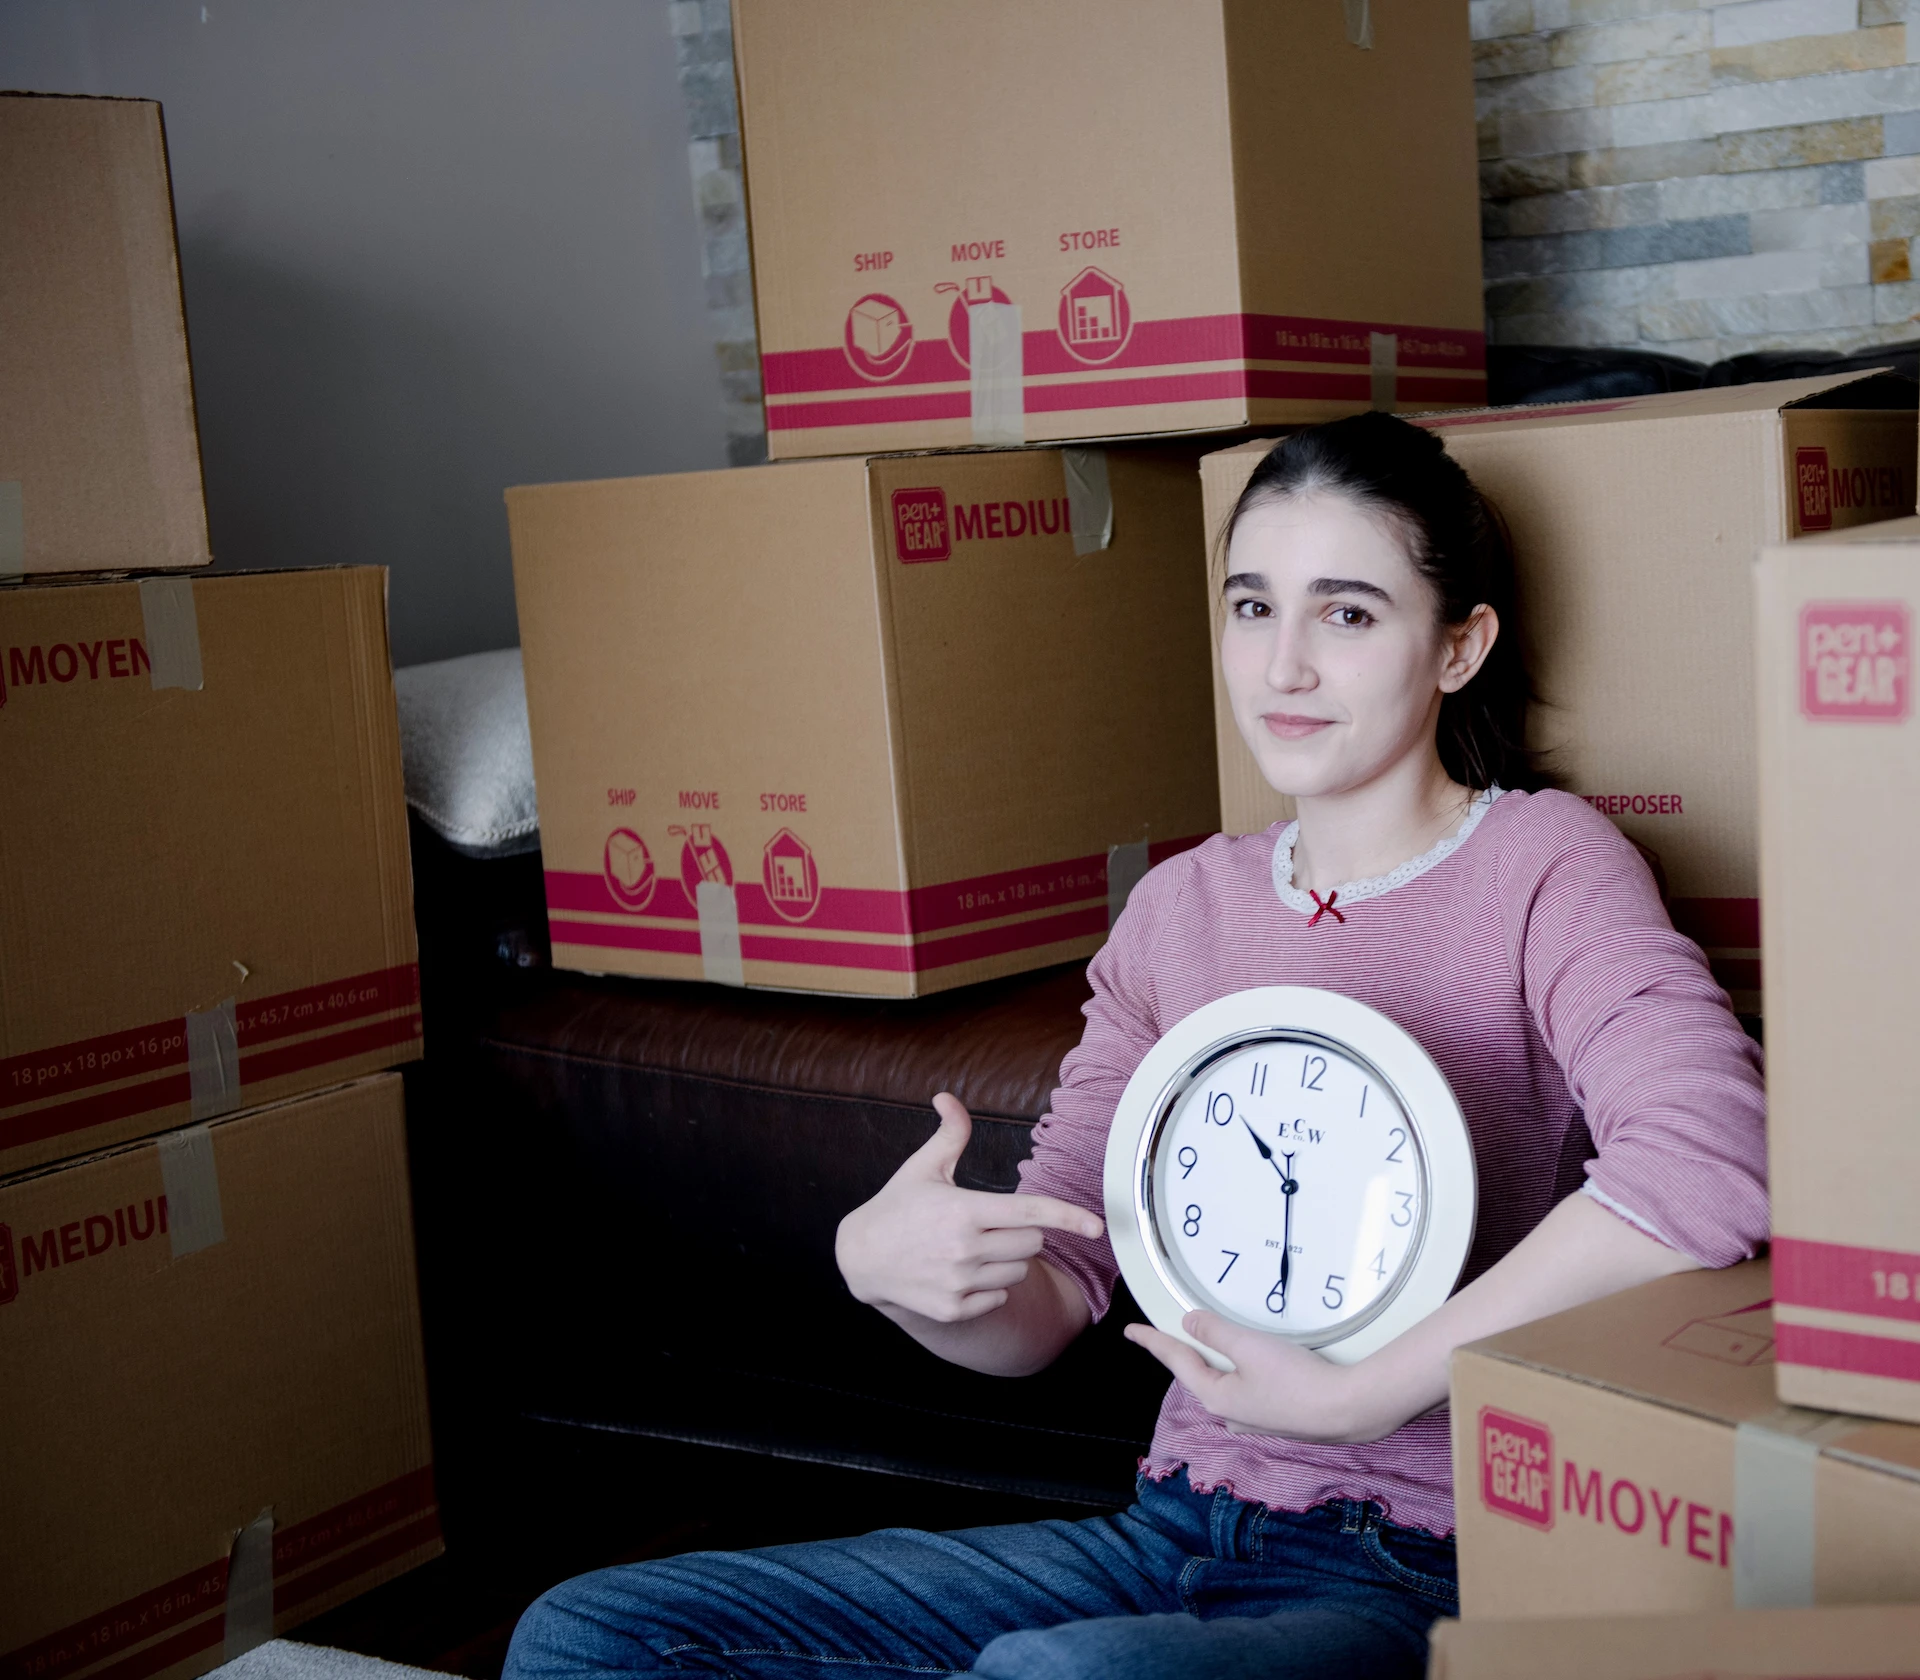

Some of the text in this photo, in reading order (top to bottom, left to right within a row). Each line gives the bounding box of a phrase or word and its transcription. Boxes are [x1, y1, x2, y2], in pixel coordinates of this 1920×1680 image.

[952, 240, 1005, 262] MOVE
[1059, 228, 1120, 251] STORE
[854, 252, 893, 272] SHIP
[1833, 467, 1904, 508] MOYEN
[607, 789, 636, 806] SHIP
[679, 791, 720, 810] MOVE
[760, 794, 807, 812] STORE
[957, 892, 974, 910] 18
[998, 890, 1006, 902] x
[1009, 884, 1026, 900] 18
[1048, 880, 1056, 892] x
[1059, 874, 1075, 890] 16
[248, 1017, 257, 1030] x
[260, 1005, 290, 1026] 45,7
[293, 1002, 314, 1018] cm
[316, 999, 325, 1012] x
[328, 988, 356, 1010] 40,6
[360, 986, 379, 1002] cm
[11, 1066, 33, 1088] 18
[36, 1062, 59, 1086] po
[62, 1060, 73, 1074] x
[76, 1050, 98, 1072] 18
[100, 1046, 122, 1070] po
[125, 1045, 136, 1058] x
[138, 1036, 158, 1056] 16
[1250, 1062, 1268, 1096] 11
[1301, 1054, 1328, 1092] 12
[1205, 1090, 1234, 1126] 10
[1360, 1084, 1368, 1118] 1
[1386, 1128, 1407, 1163] 2
[1178, 1146, 1198, 1180] 9
[1183, 1204, 1202, 1237] 8
[1390, 1190, 1414, 1227] 3
[1217, 1250, 1240, 1284] 7
[1368, 1248, 1387, 1281] 4
[1266, 1279, 1286, 1313] 6
[1322, 1274, 1346, 1310] 5
[1872, 1270, 1910, 1301] 18
[1485, 1426, 1546, 1466] pen+
[90, 1626, 110, 1648] 18
[139, 1610, 150, 1626] x
[153, 1596, 172, 1619] 16
